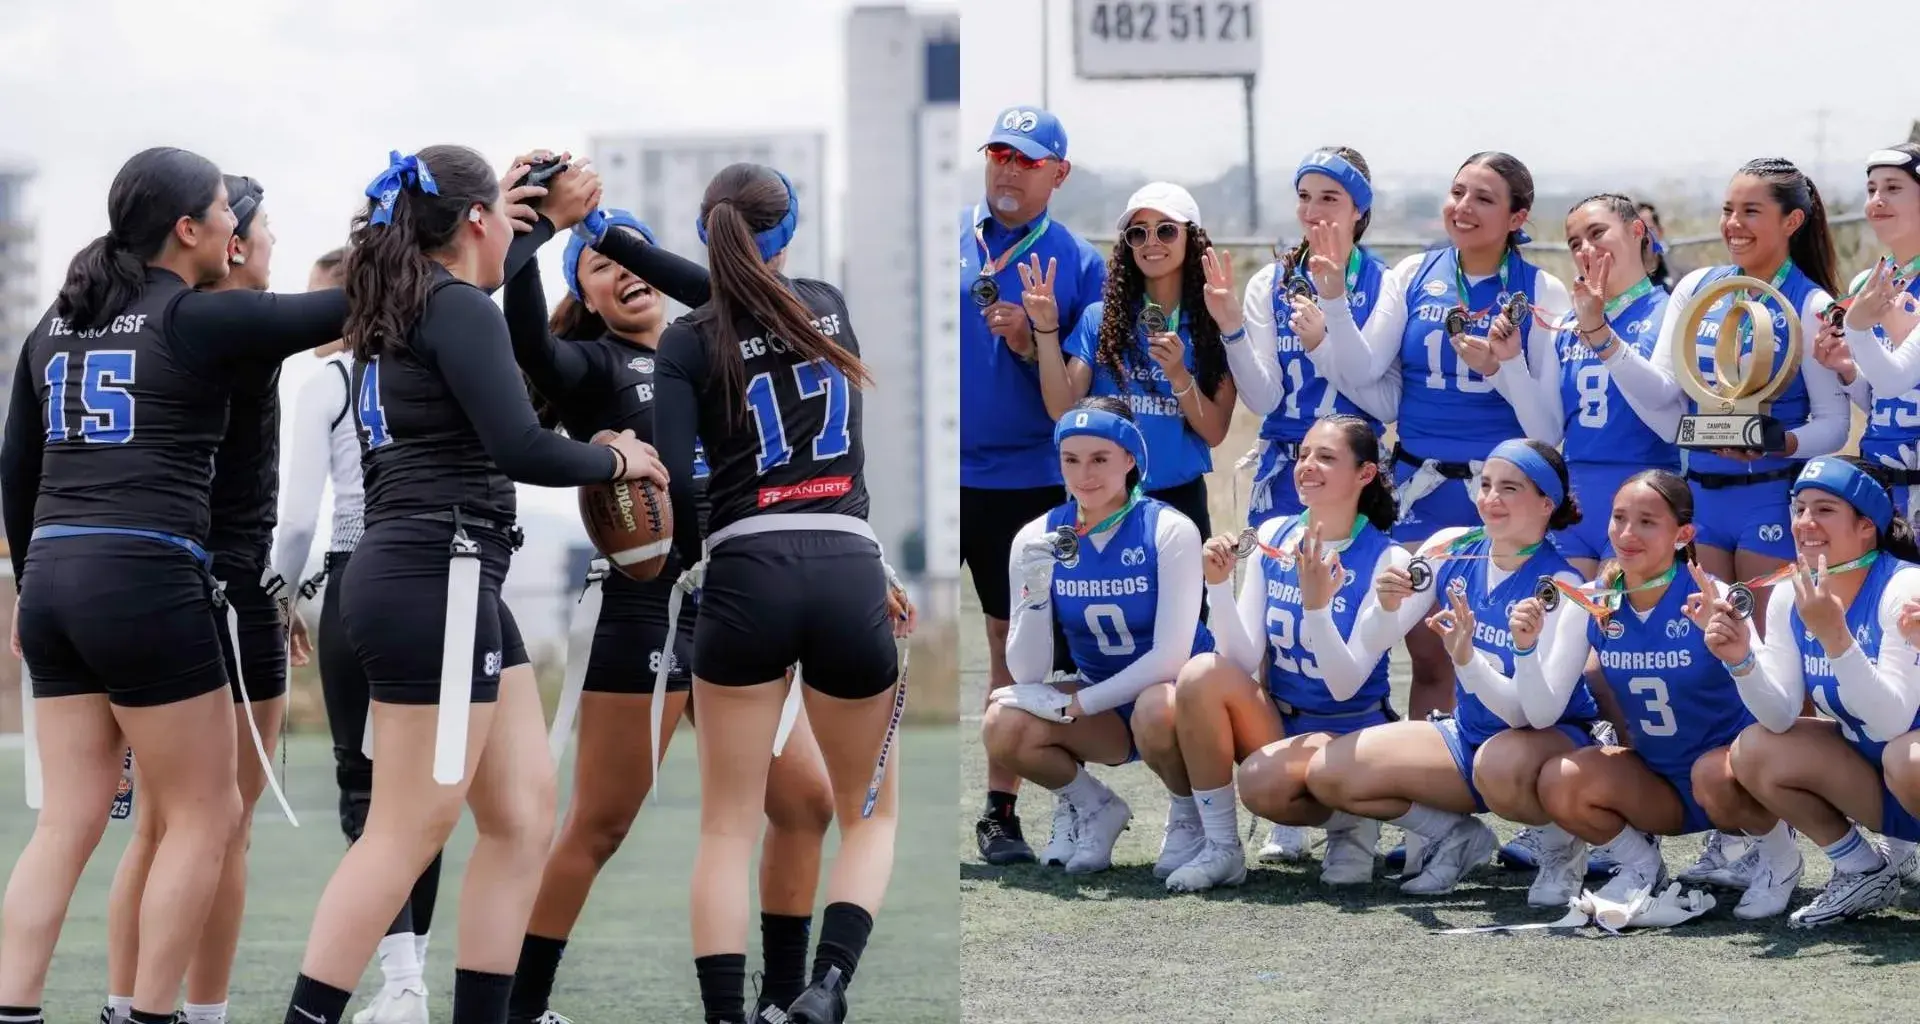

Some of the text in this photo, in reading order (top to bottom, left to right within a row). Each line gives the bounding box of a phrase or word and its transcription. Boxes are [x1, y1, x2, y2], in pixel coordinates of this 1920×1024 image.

[1091, 4, 1254, 41] 482 51 21
[1307, 152, 1331, 167] 17
[111, 314, 148, 334] CSF
[739, 336, 767, 360] EC
[45, 350, 136, 444] 15
[358, 355, 393, 450] 4
[1577, 365, 1610, 429] 8
[745, 356, 851, 476] 17
[1076, 412, 1088, 428] 0
[1799, 461, 1825, 480] 15
[1055, 575, 1149, 597] BORREGOS
[1083, 603, 1137, 656] 0
[1600, 649, 1692, 670] BORREGOS
[1628, 677, 1678, 737] 3
[111, 801, 130, 817] 25
